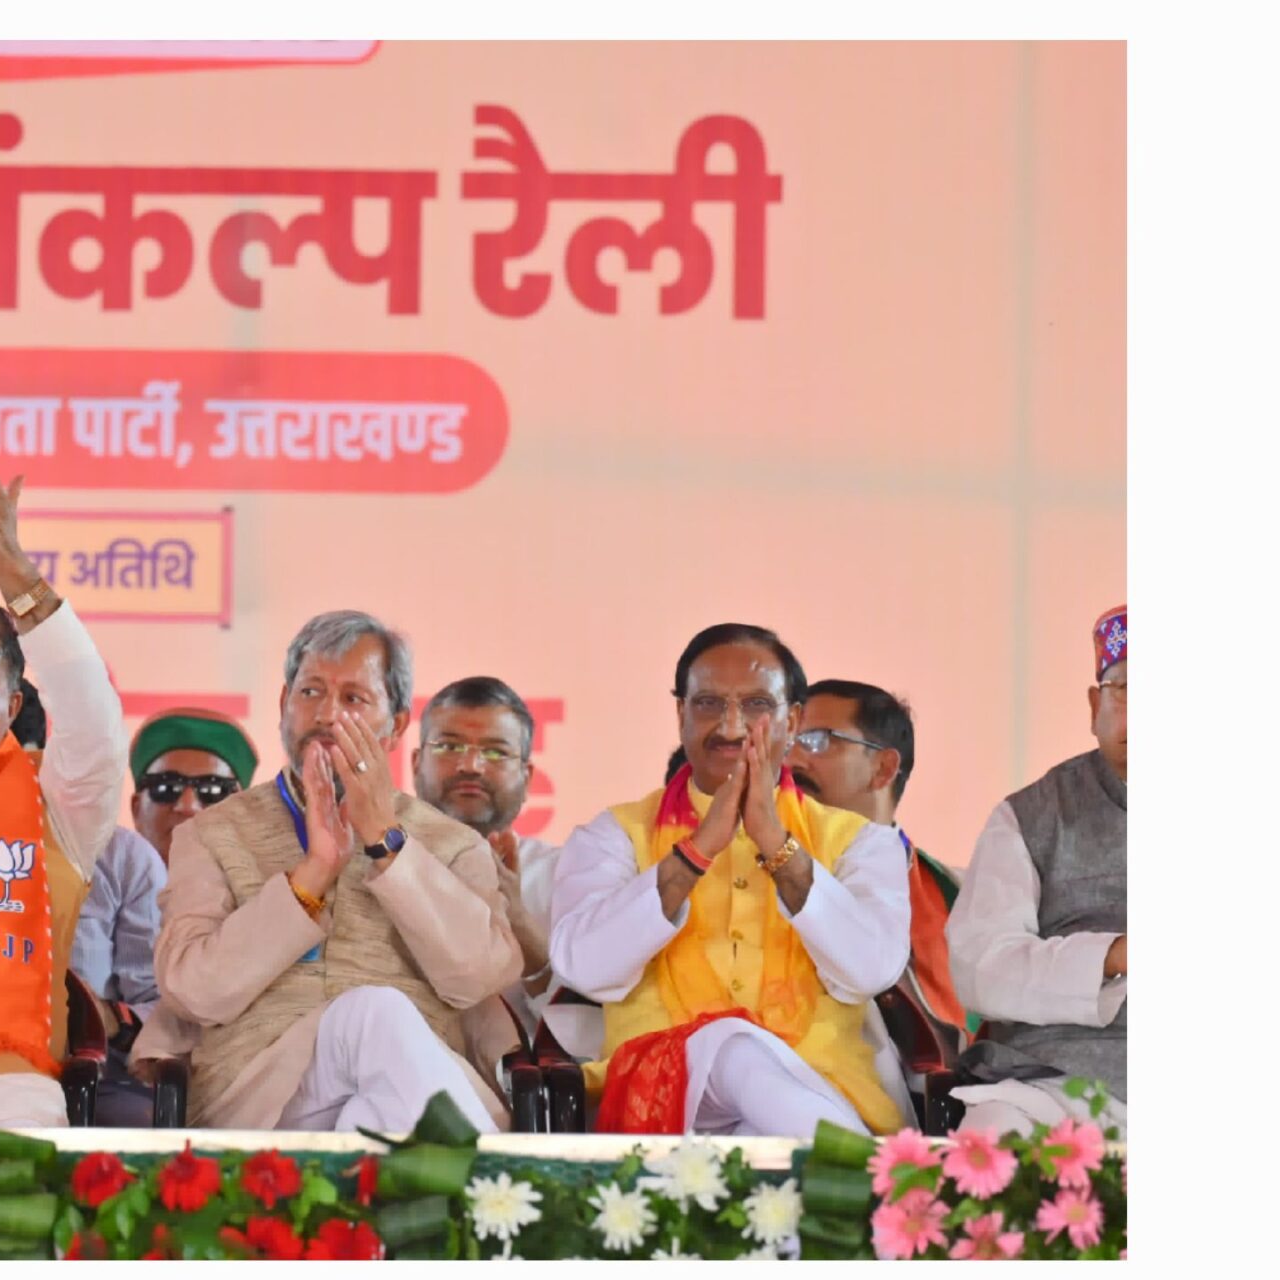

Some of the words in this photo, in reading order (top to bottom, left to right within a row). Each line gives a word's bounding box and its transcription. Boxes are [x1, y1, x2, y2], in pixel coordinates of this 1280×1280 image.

[460, 104, 783, 320] रैली
[69, 381, 191, 467] पार्टी,
[205, 400, 467, 464] उत्तराखण्ड
[70, 538, 195, 590] अतिथि
